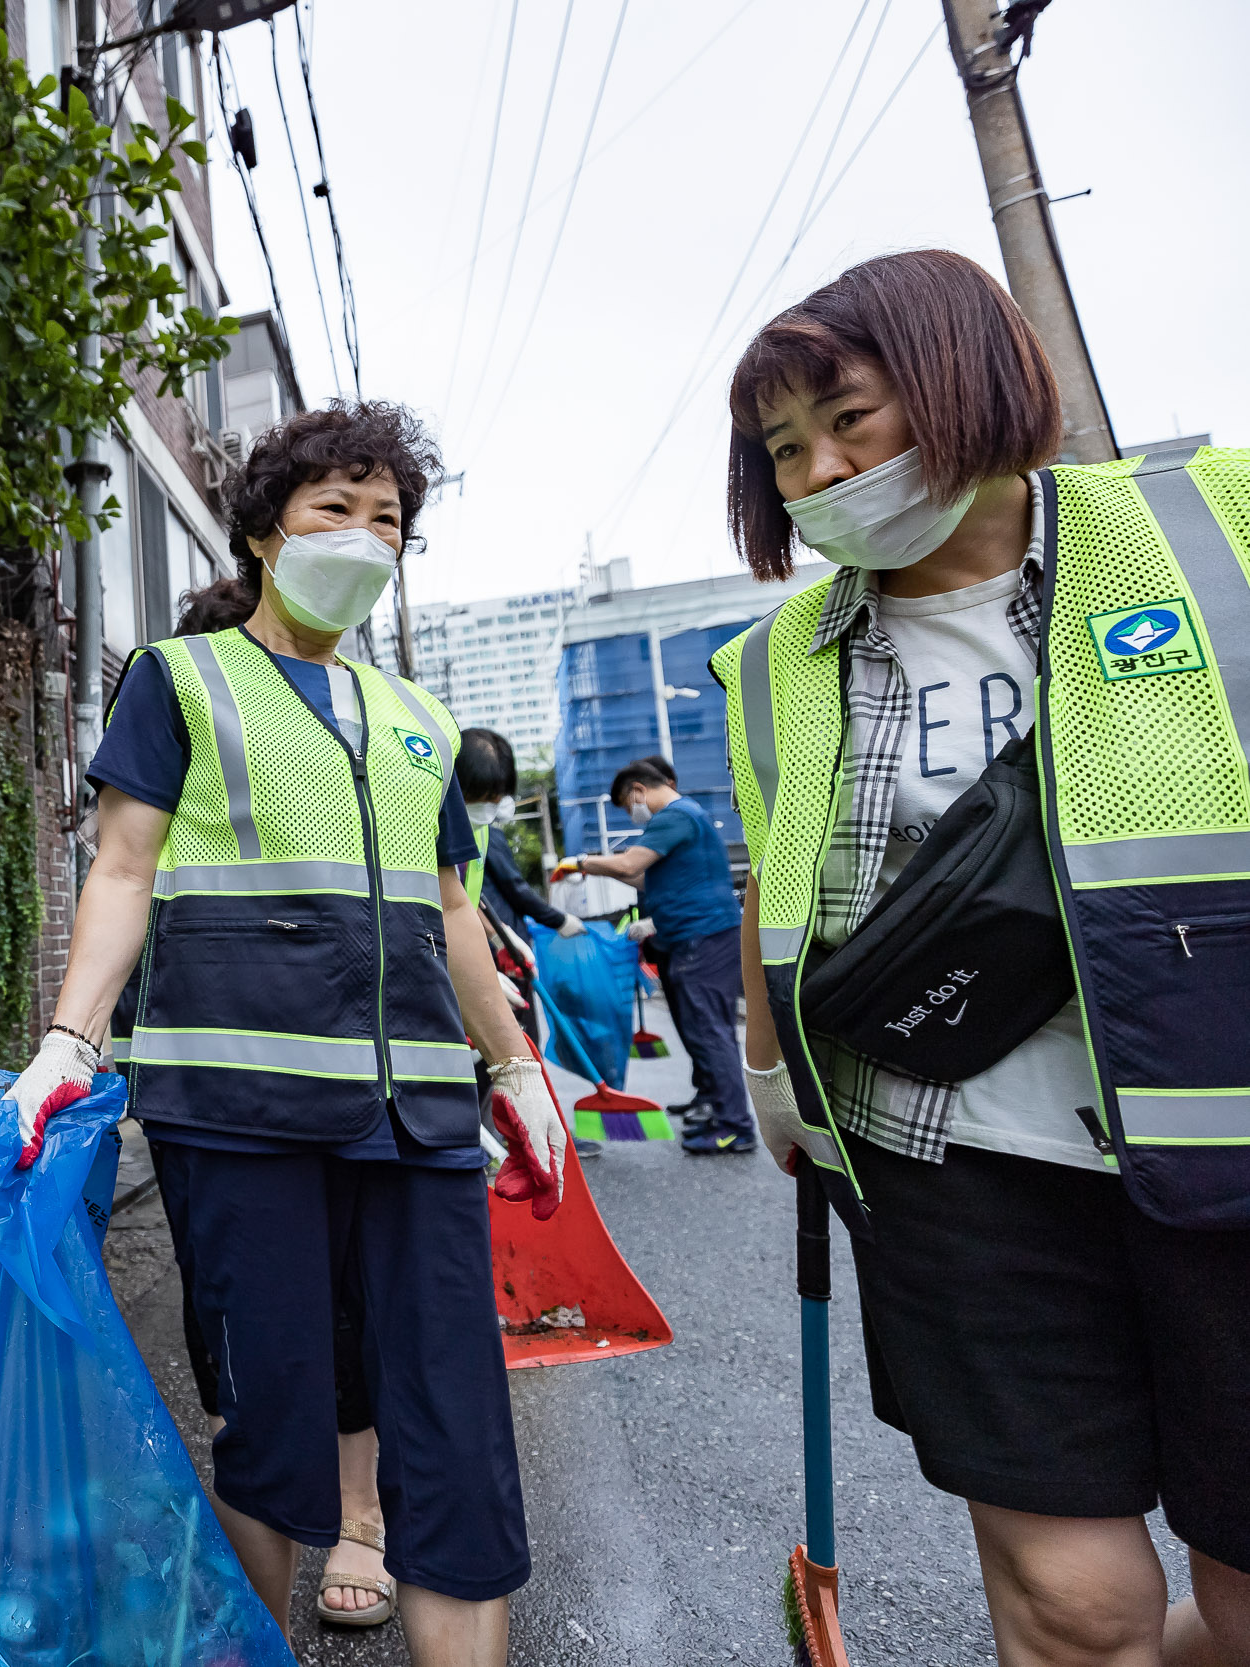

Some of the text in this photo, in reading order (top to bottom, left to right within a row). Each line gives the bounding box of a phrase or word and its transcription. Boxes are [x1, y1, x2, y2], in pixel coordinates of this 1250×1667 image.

[1110, 649, 1193, 674] 광진구
[884, 969, 980, 1038] Just do it.
